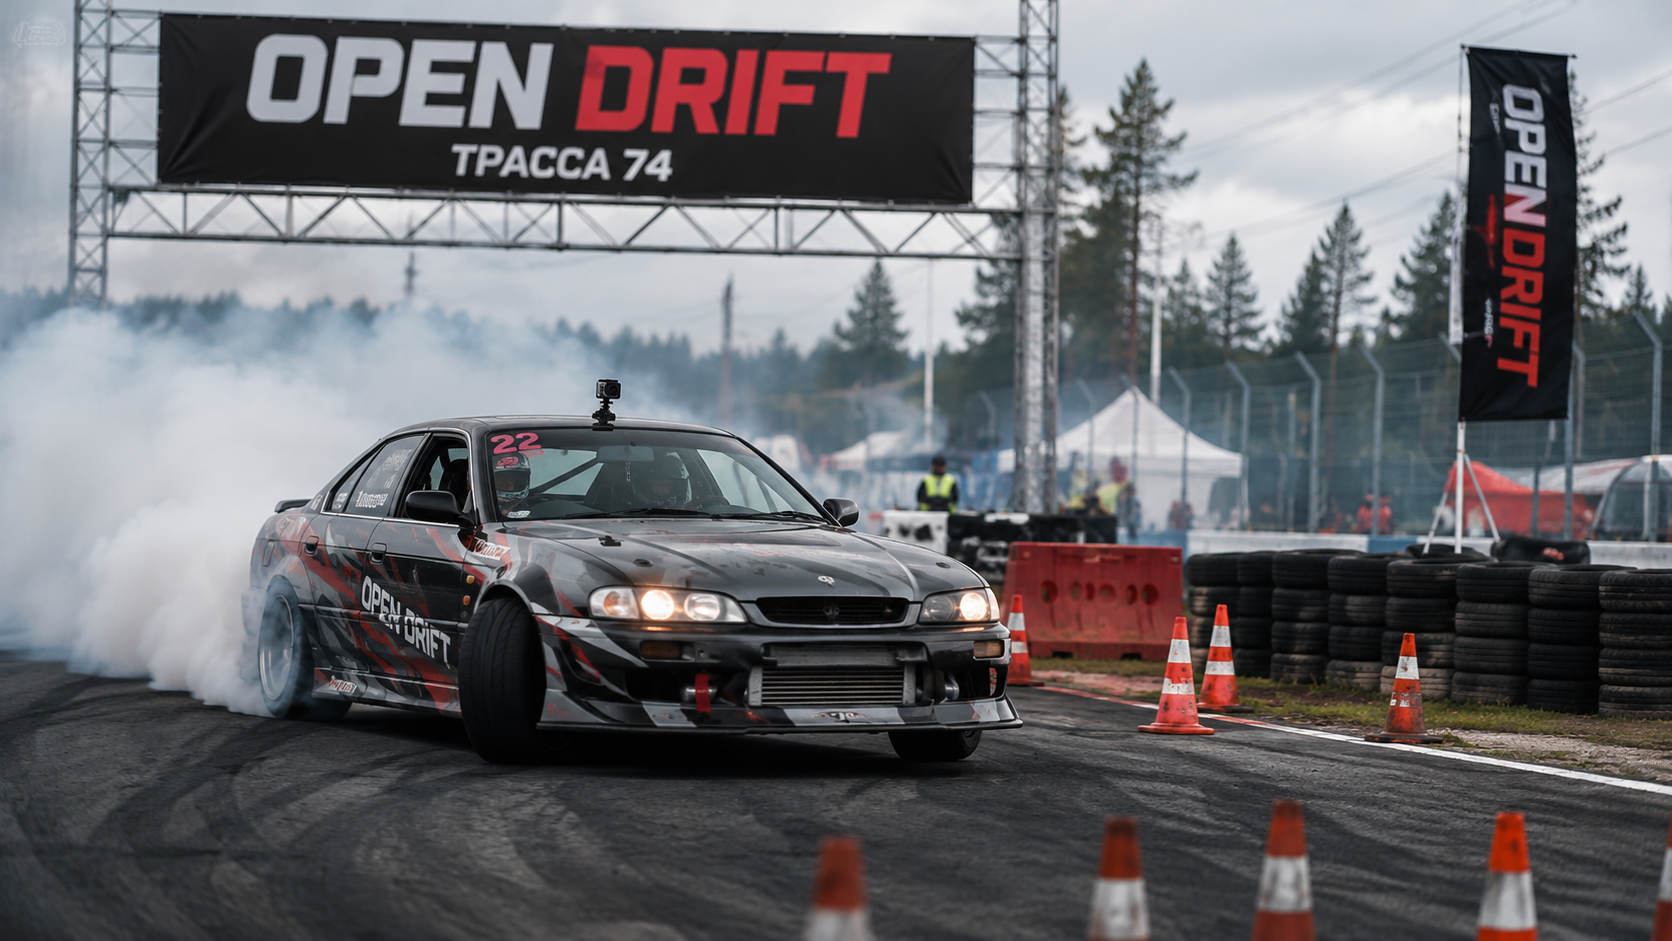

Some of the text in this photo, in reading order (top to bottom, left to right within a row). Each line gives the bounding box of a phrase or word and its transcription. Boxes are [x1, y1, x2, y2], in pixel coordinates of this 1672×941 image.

[247, 34, 892, 138] OPEN DRIFT
[452, 143, 673, 182] ТРАССА 74
[490, 432, 542, 455] 22
[361, 575, 451, 669] OPEN DRIFT
